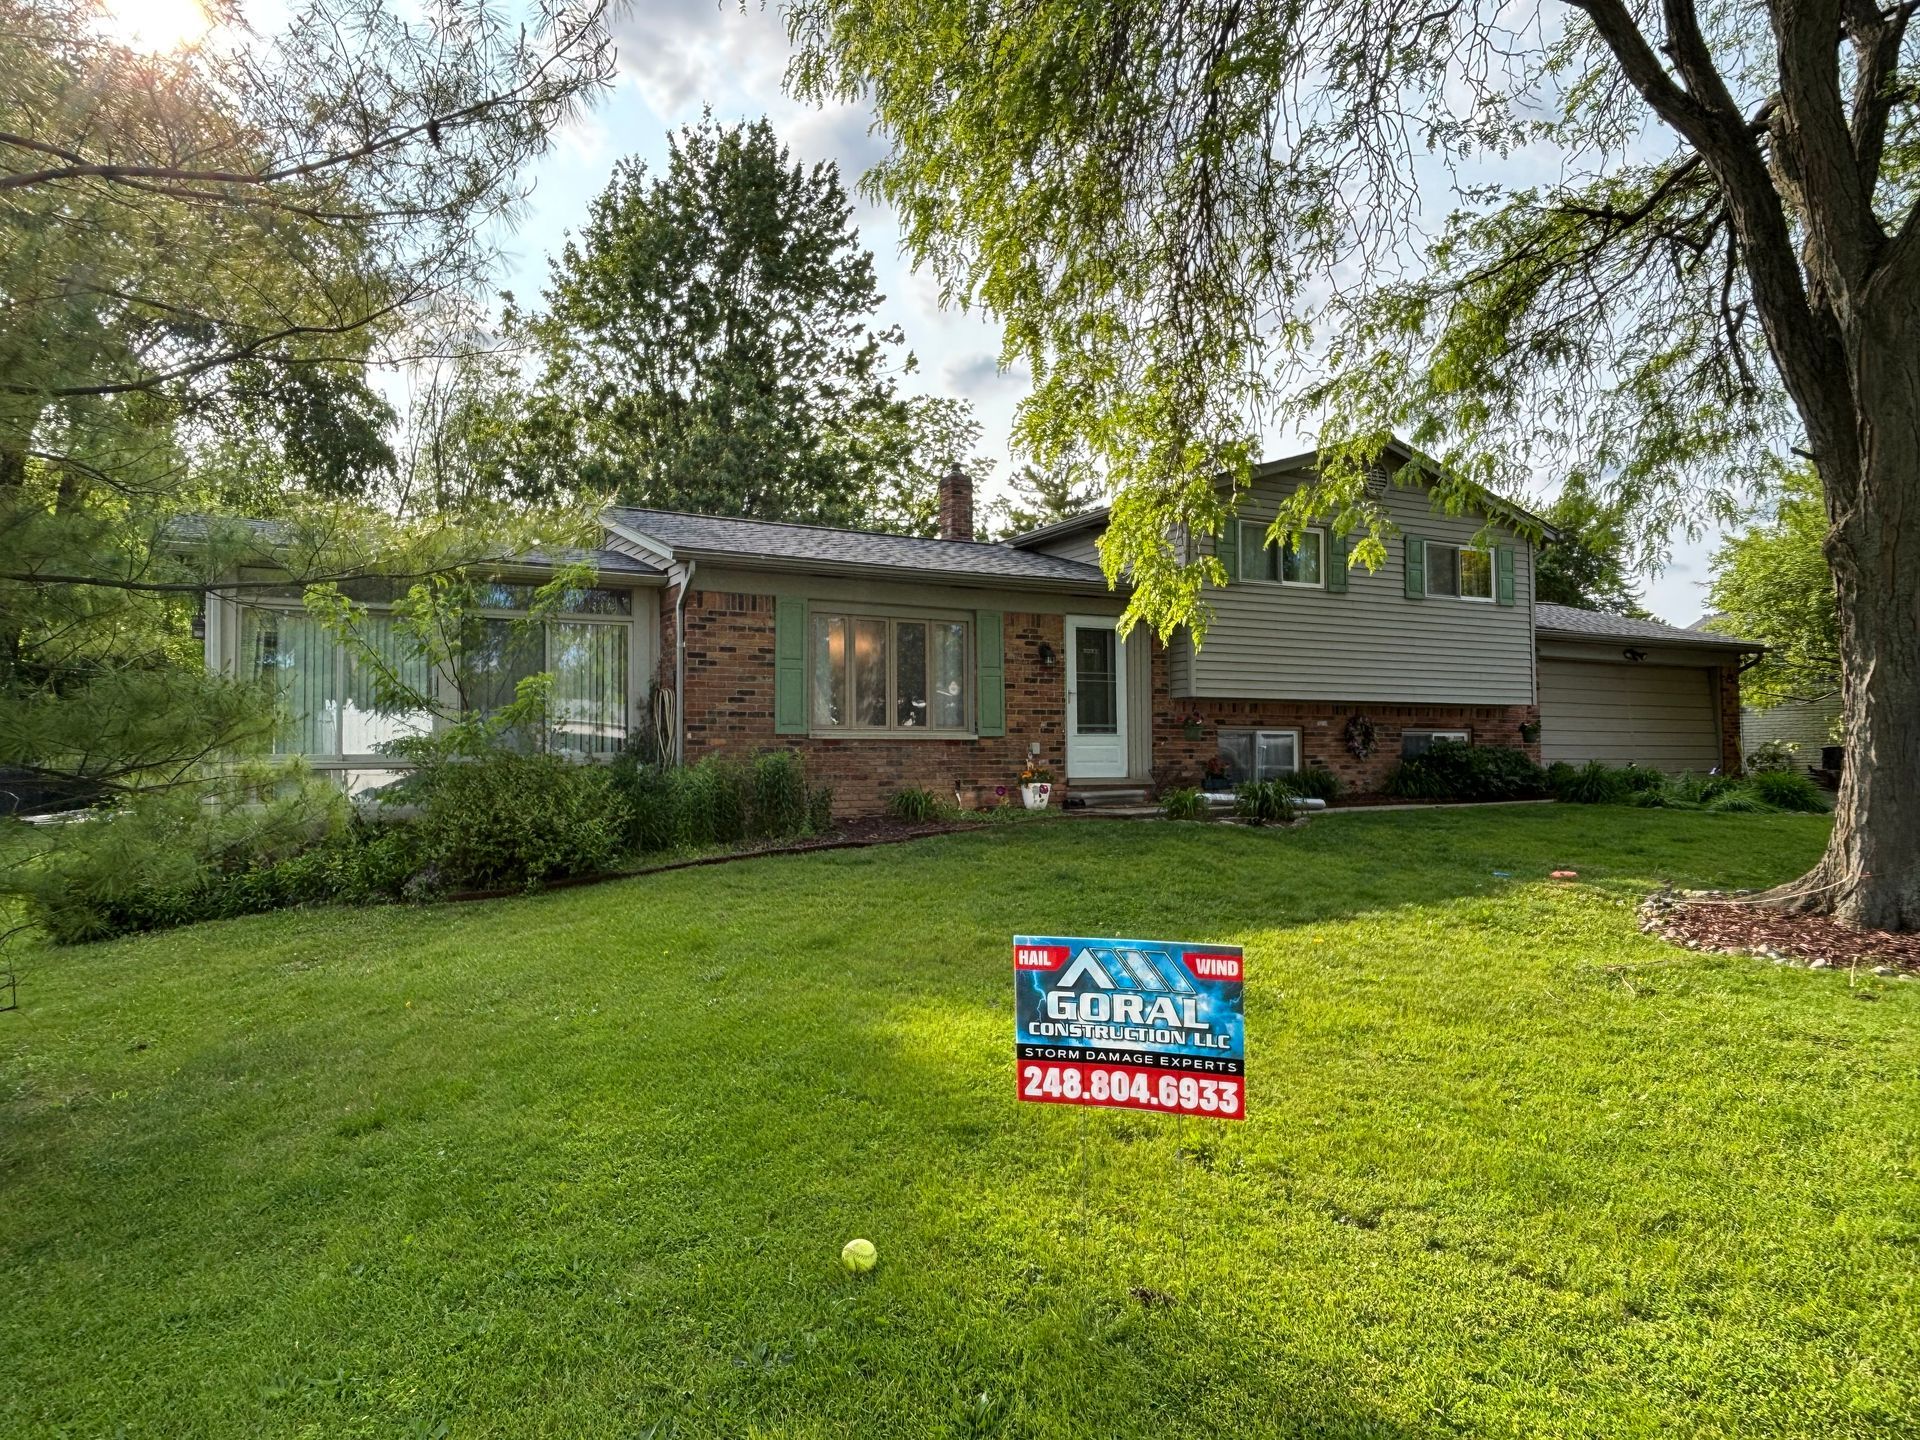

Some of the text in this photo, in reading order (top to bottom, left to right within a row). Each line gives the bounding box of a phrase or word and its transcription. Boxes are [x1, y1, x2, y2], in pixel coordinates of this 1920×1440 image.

[1018, 950, 1052, 966] HAIL
[1195, 958, 1239, 977] WIND
[1046, 991, 1210, 1029] GORAL
[1028, 1021, 1231, 1049] CONSTRUCTION LLC
[1025, 1048, 1237, 1072] STORM DAMAGE EXPERTS
[1023, 1065, 1239, 1113] 248.804.6933
